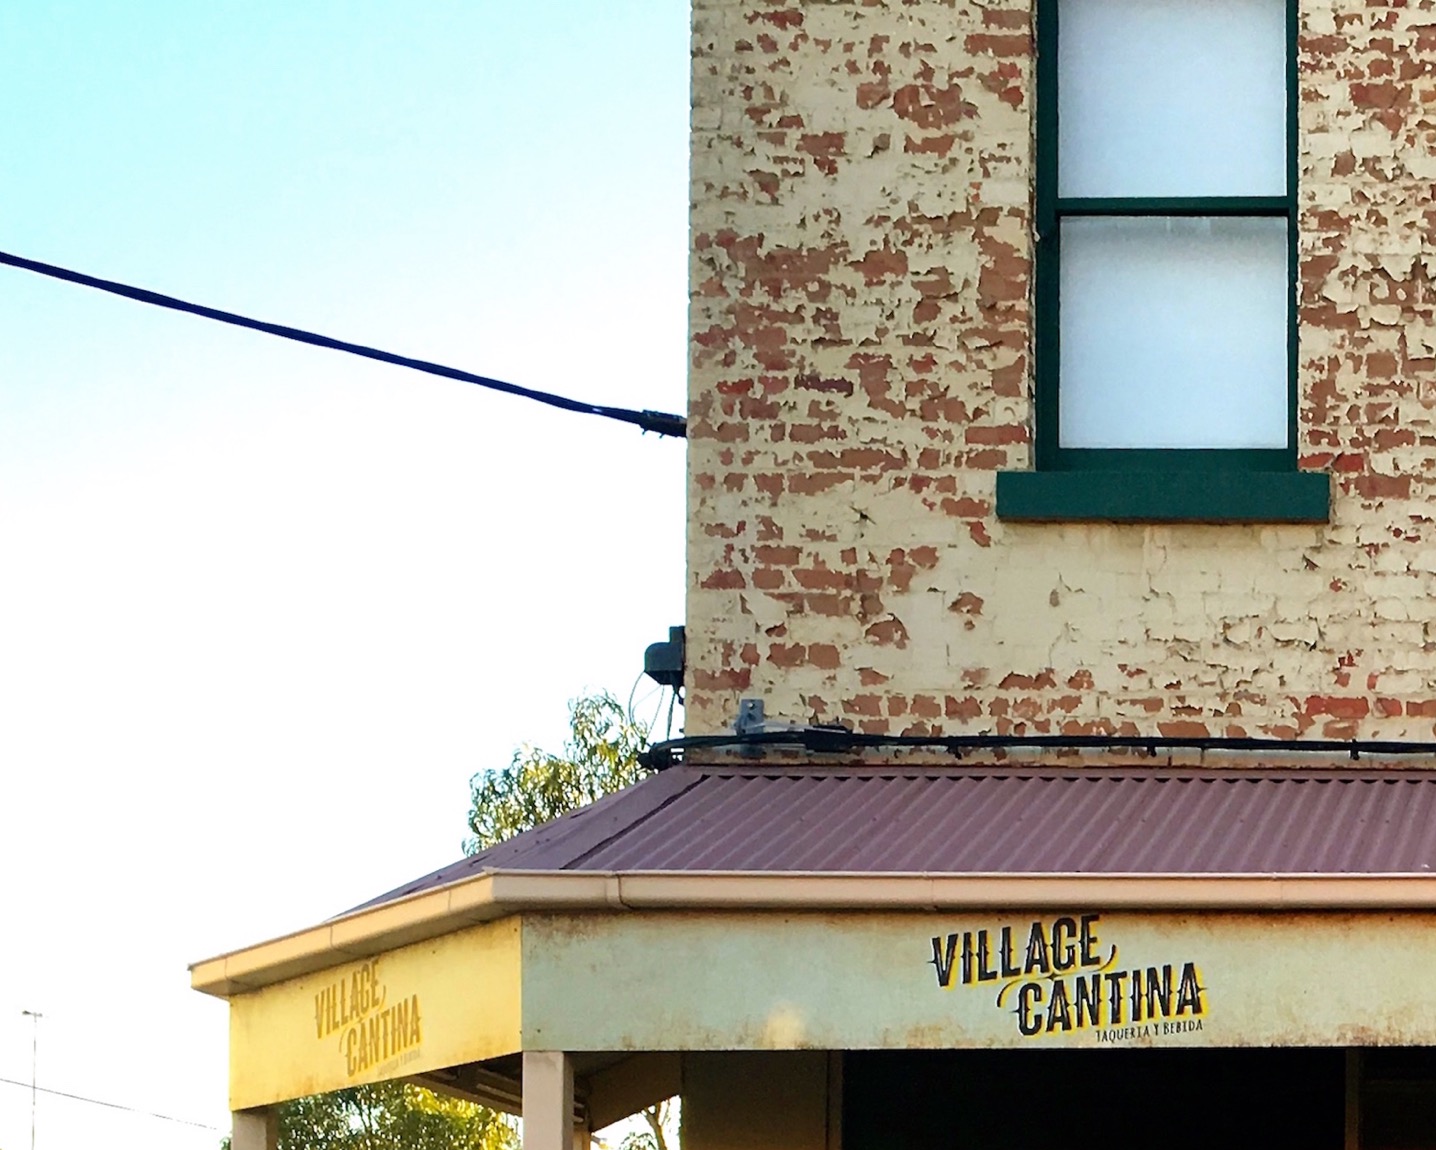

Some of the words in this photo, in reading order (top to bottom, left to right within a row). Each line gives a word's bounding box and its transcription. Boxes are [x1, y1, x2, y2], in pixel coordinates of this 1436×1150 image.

[930, 914, 1101, 988] VILLAGE
[314, 958, 380, 1040] VILLAGE
[345, 993, 421, 1077] CANTINA
[1015, 962, 1205, 1036] CANTINA
[1095, 1024, 1150, 1042] TAQUERIA
[1152, 1023, 1161, 1036] Y
[1163, 1018, 1204, 1035] BEBIDA
